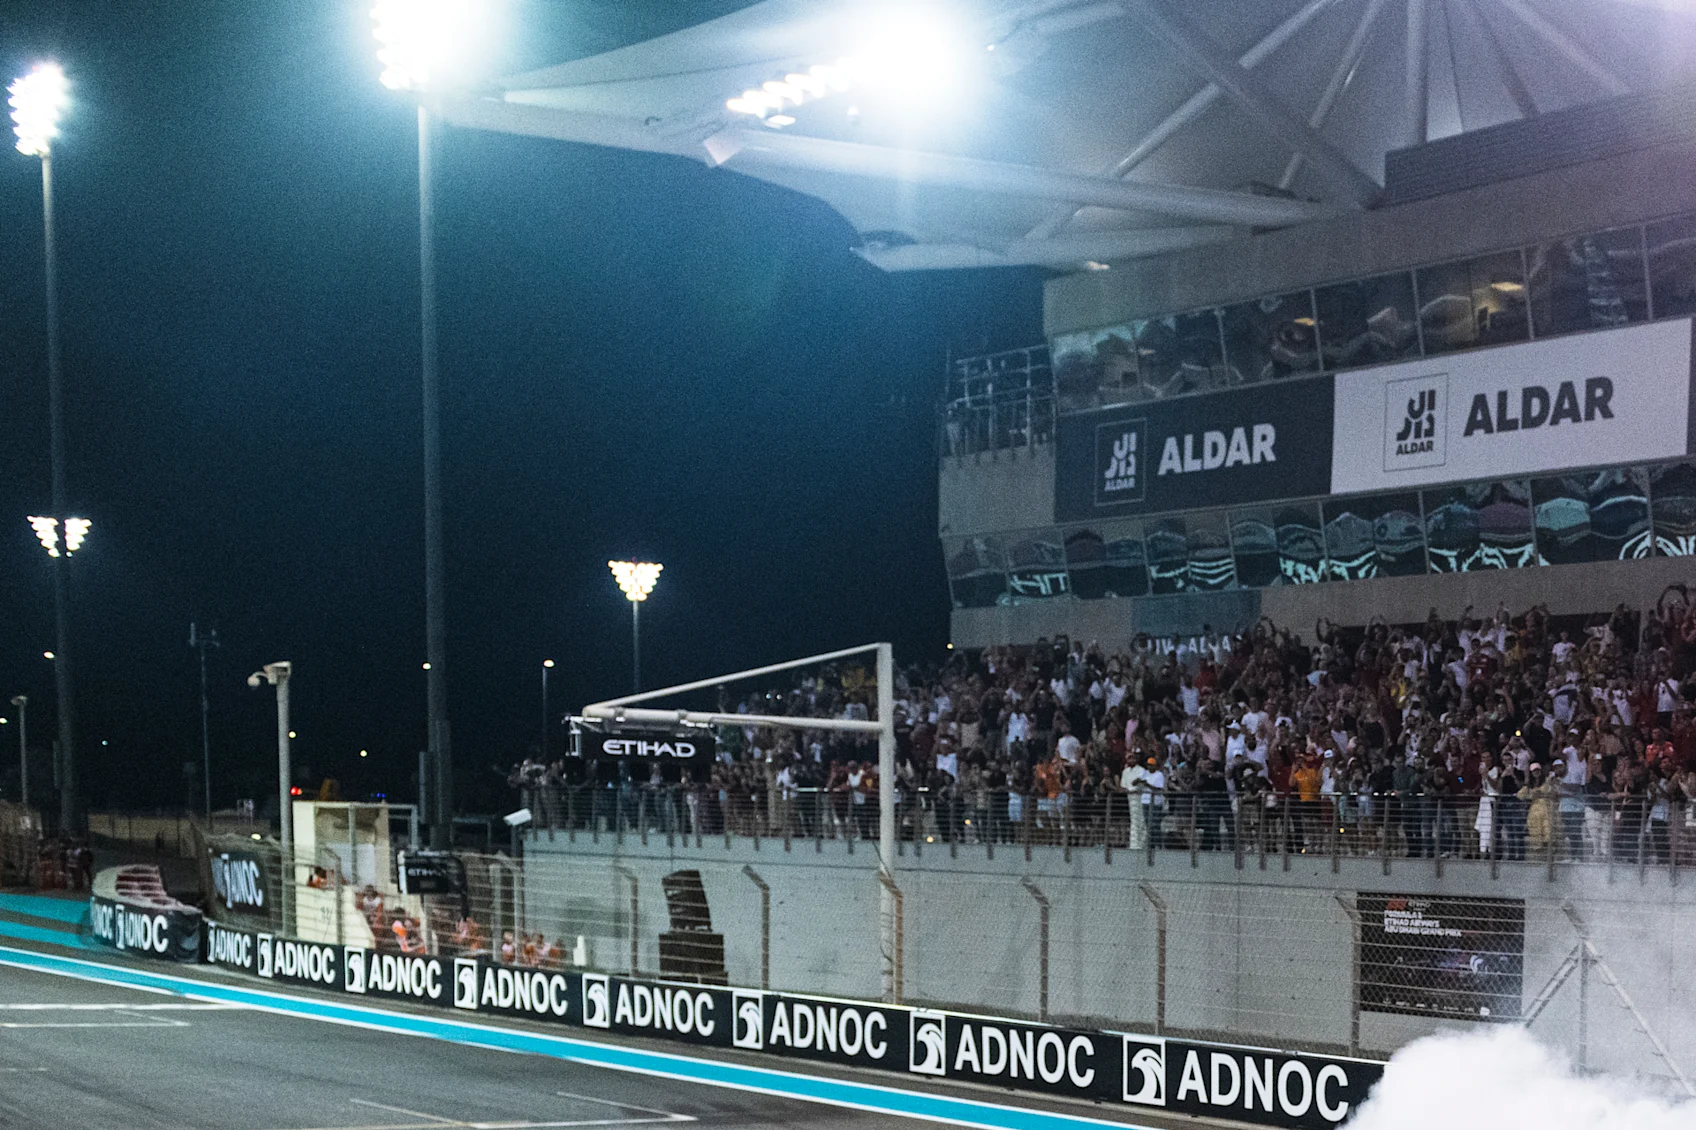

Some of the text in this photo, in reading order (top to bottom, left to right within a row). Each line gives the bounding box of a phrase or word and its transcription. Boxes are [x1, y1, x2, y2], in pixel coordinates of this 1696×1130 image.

[1463, 376, 1615, 437] ALDAR
[1158, 423, 1277, 475] ALDAR
[1396, 440, 1434, 456] ALDAR
[1104, 478, 1136, 492] ALDAR
[602, 739, 697, 758] ETIHAD
[214, 927, 253, 969] ADNOC
[274, 941, 336, 984] ADNOC
[368, 953, 442, 999] ADNOC
[481, 967, 568, 1016] ADNOC
[614, 983, 715, 1037] ADNOC
[769, 1001, 887, 1059] ADNOC
[954, 1024, 1095, 1088] ADNOC
[1176, 1049, 1349, 1122] ADNOC
